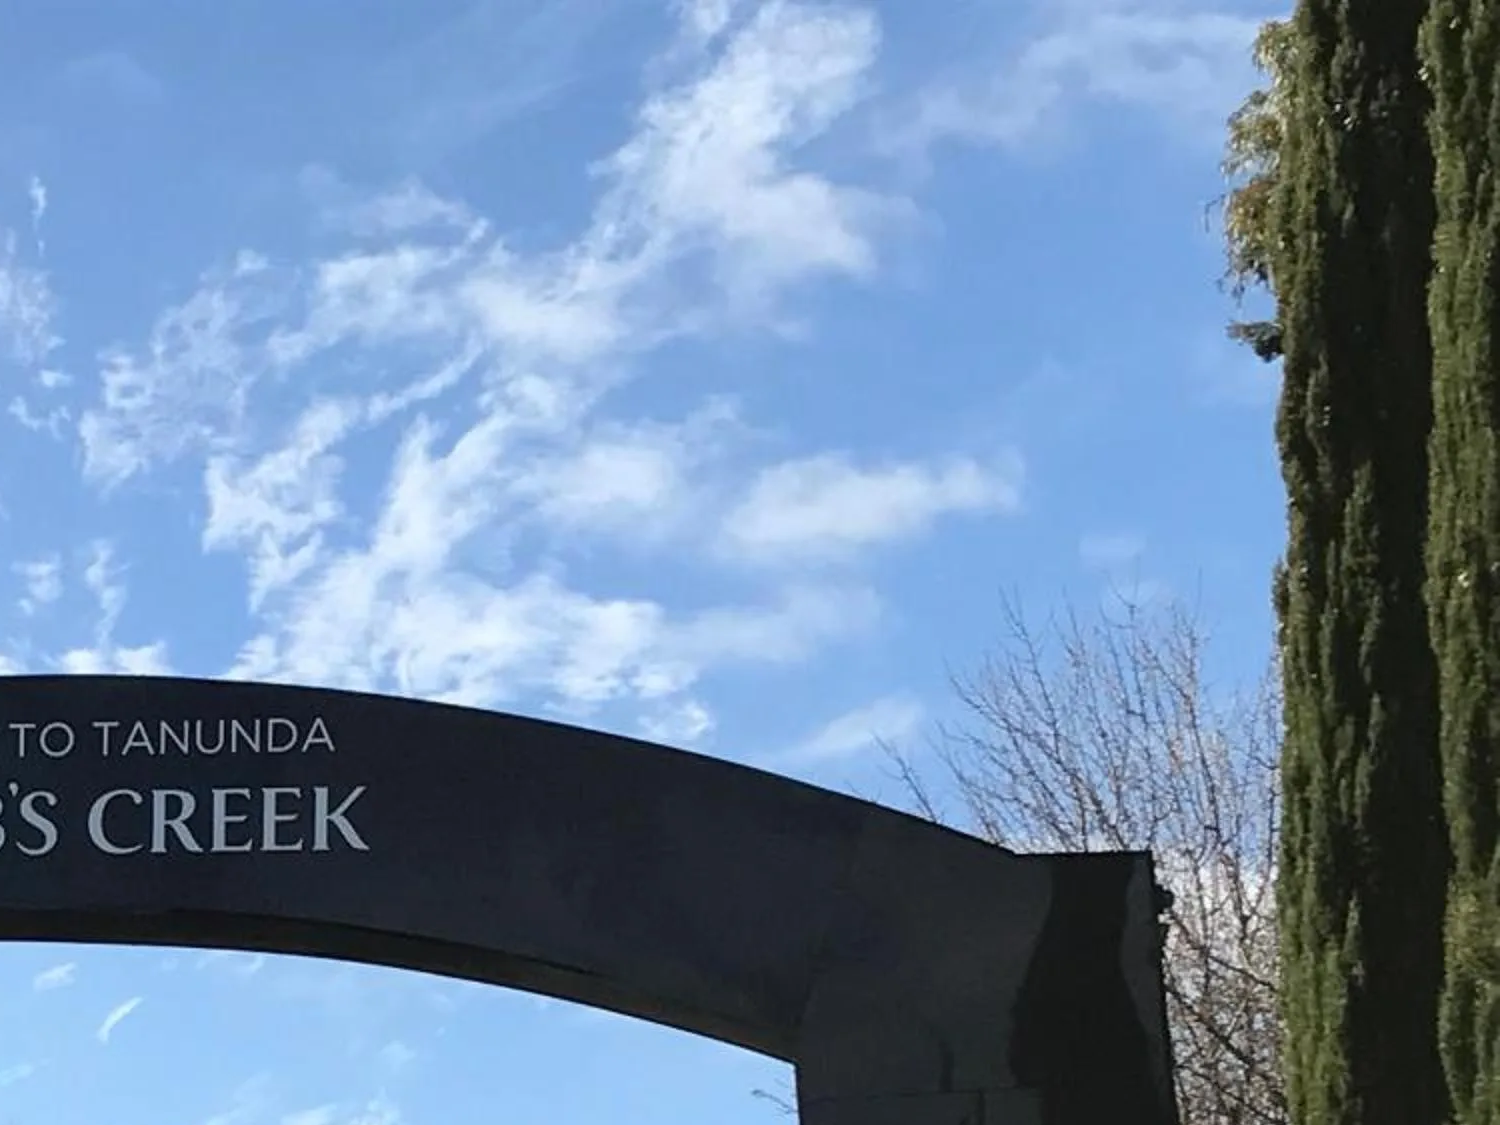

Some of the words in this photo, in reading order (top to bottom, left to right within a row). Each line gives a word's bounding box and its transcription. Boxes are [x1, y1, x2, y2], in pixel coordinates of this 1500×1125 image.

[8, 721, 75, 758] TO
[92, 717, 336, 757] TANUNDA
[87, 785, 370, 855] CREEK
